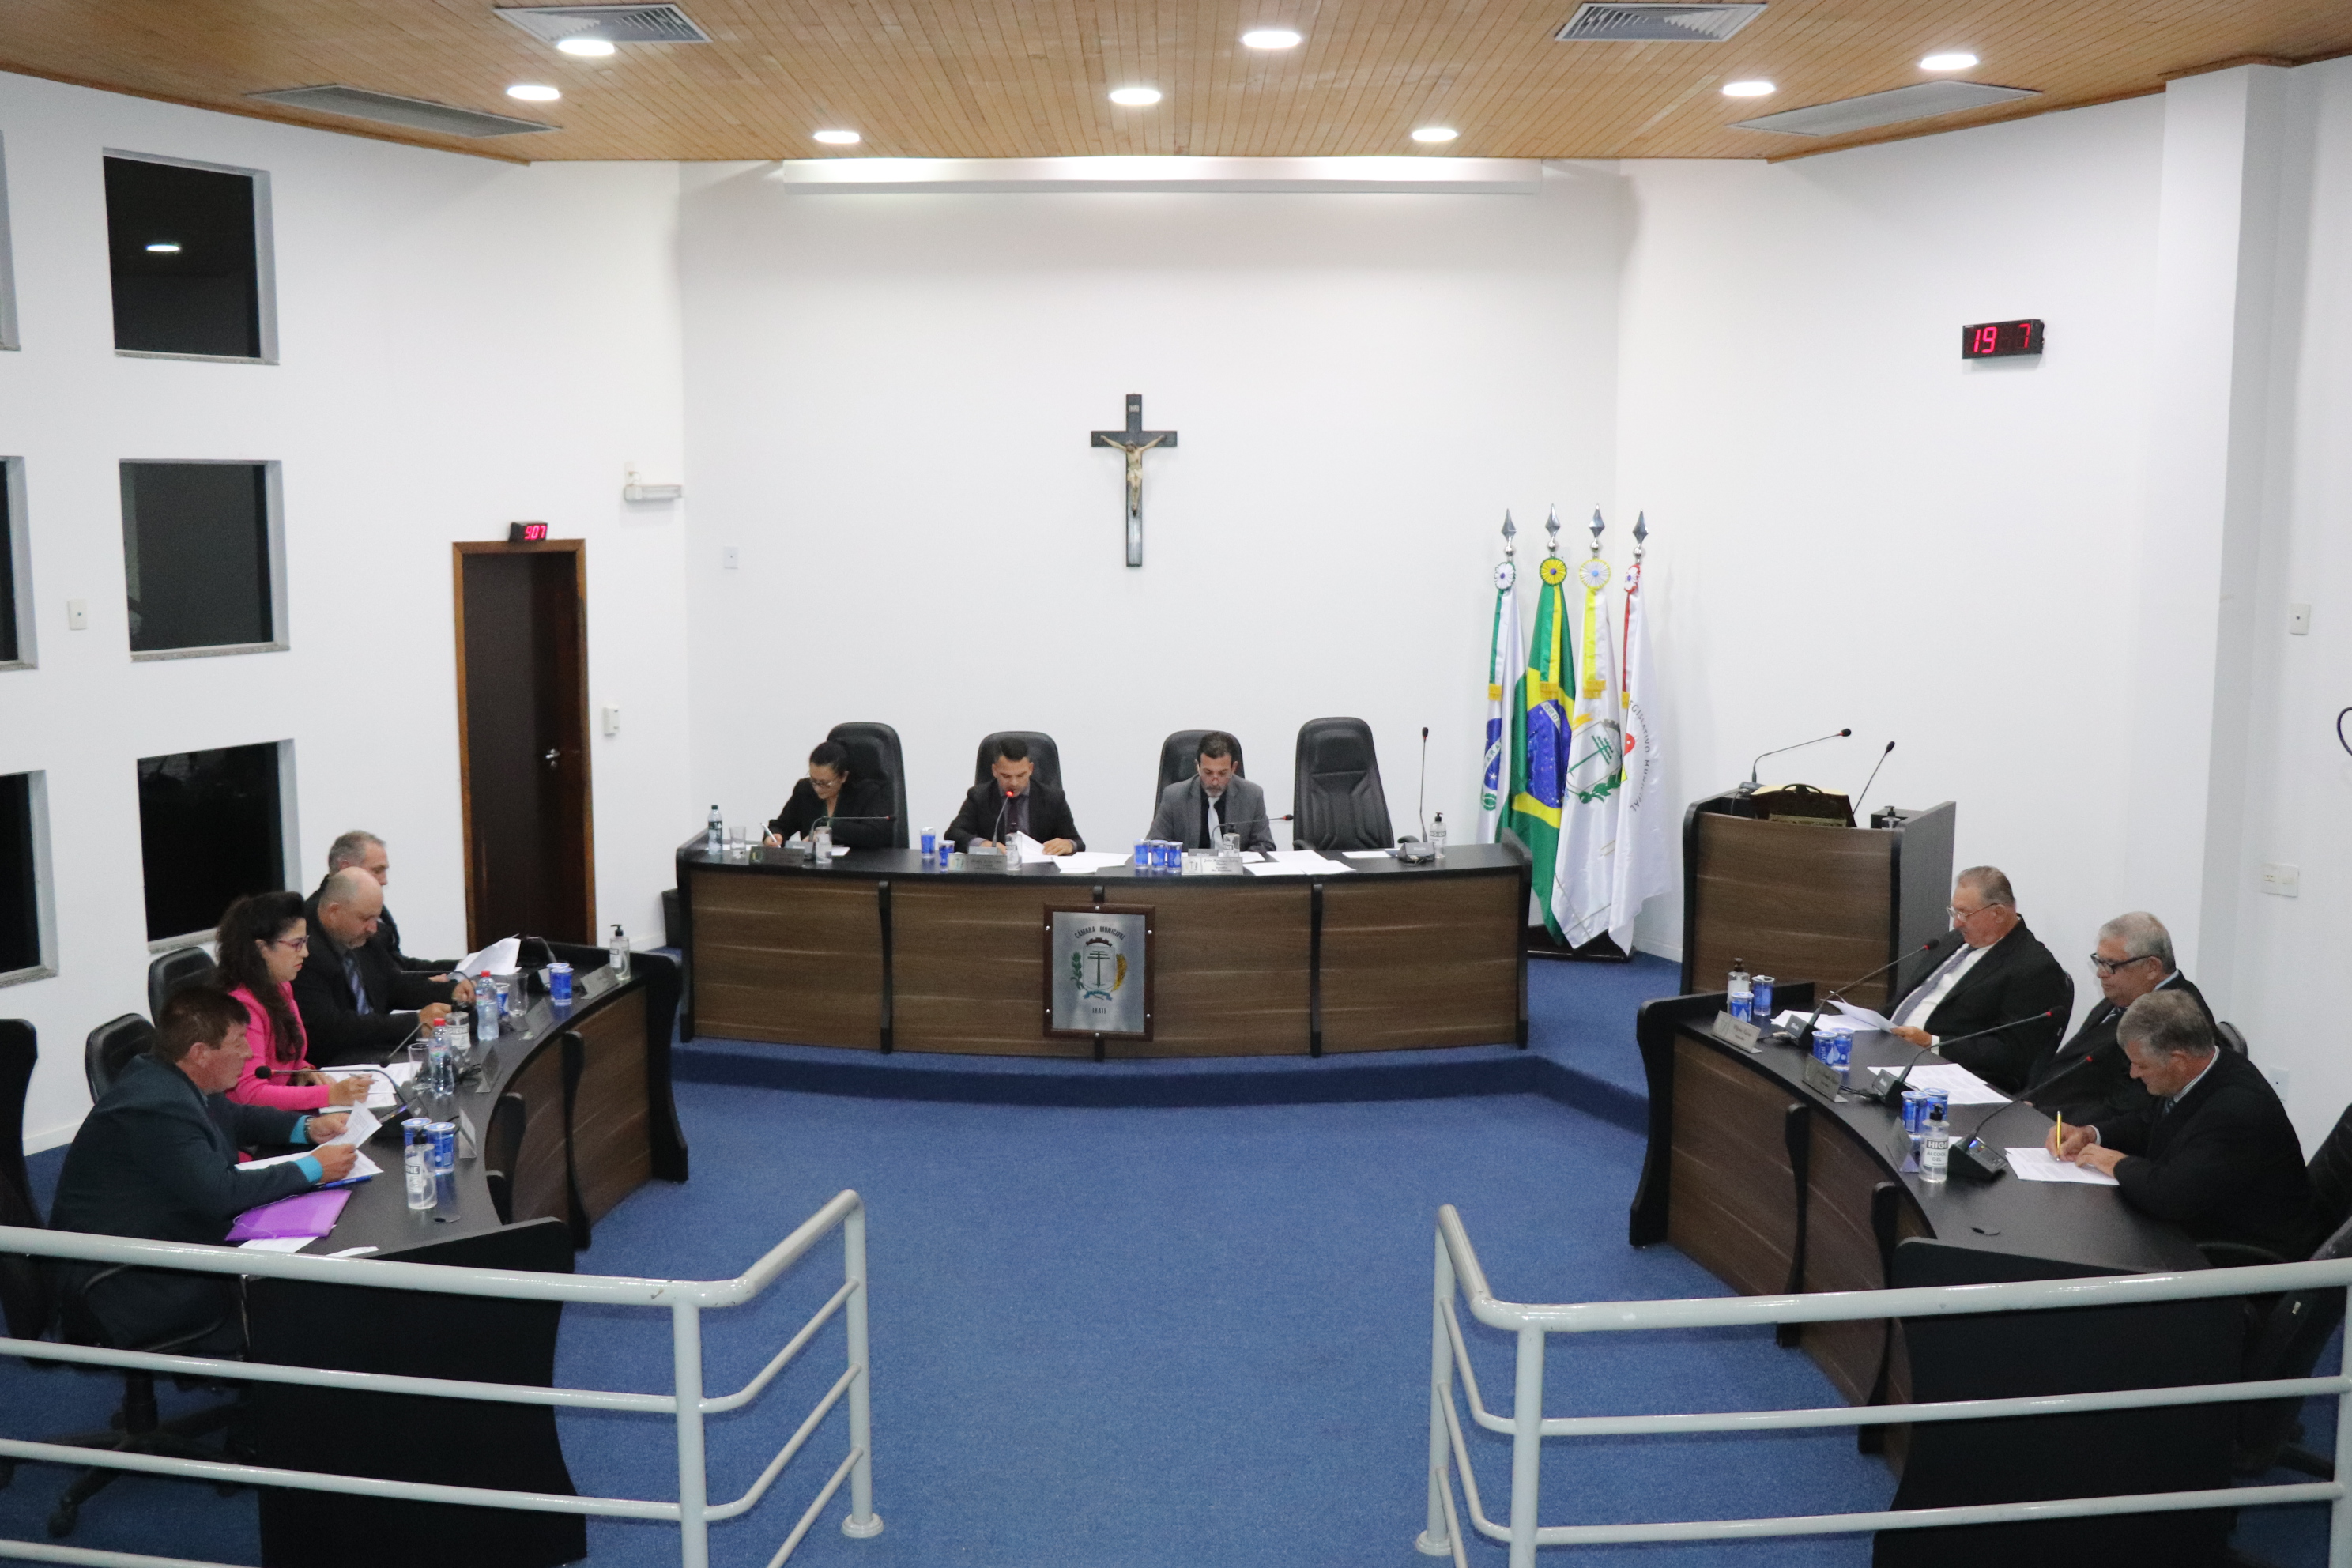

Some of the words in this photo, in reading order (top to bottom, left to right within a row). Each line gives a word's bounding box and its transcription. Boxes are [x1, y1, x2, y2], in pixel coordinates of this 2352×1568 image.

[1973, 326, 1997, 354] 19
[2018, 323, 2031, 349] 7
[1630, 700, 1650, 753] EGISLATIVO
[1099, 925, 1125, 940] MUNICIPAL
[1928, 1140, 1948, 1149] HIGI
